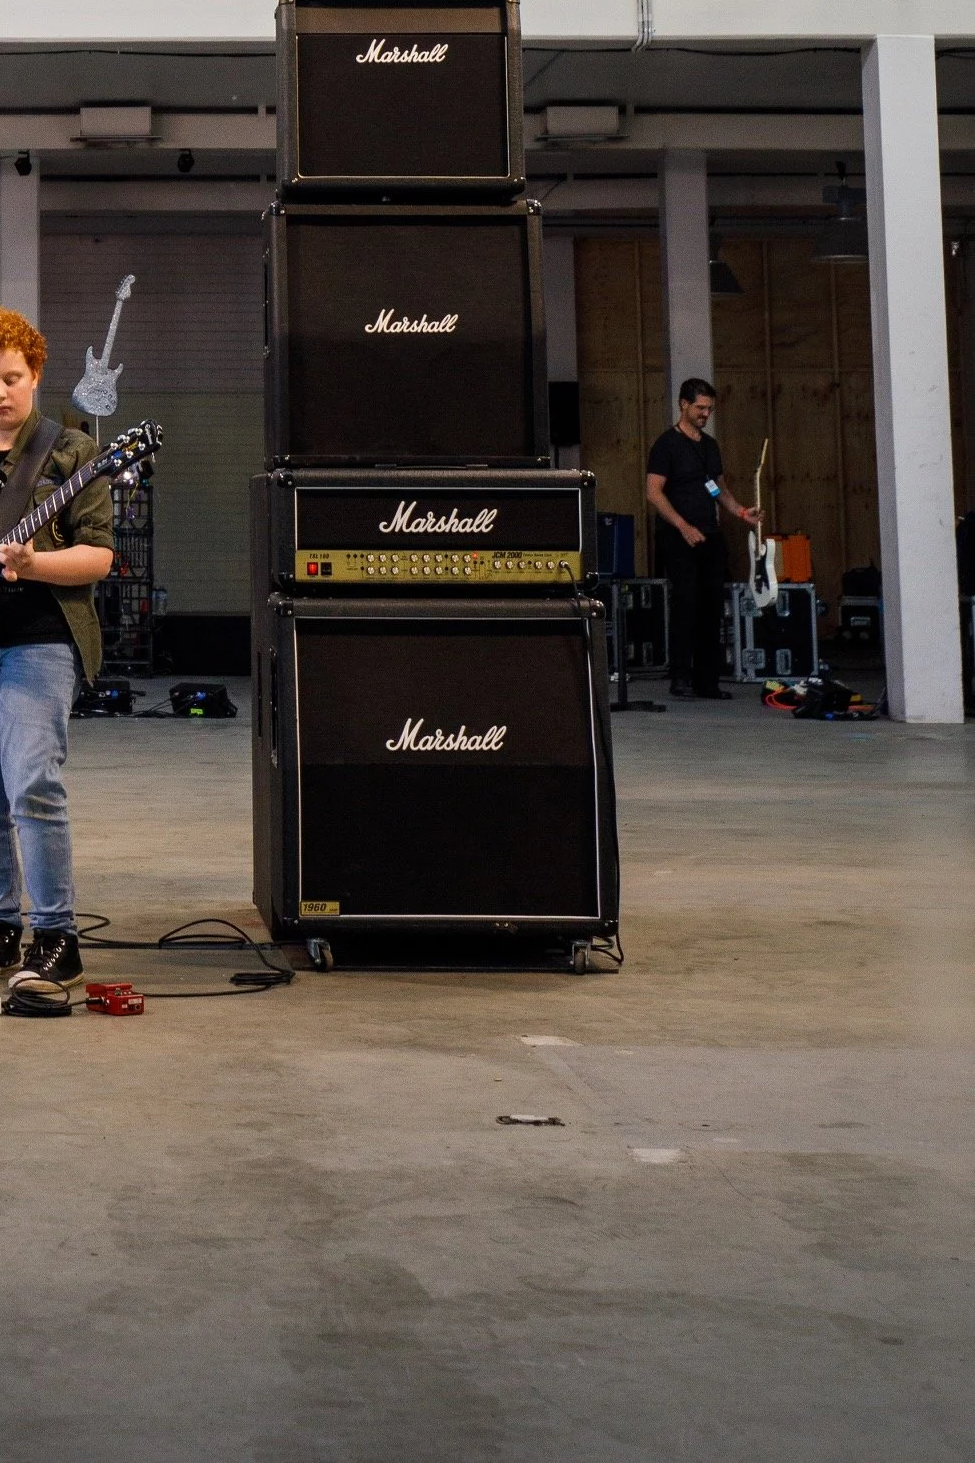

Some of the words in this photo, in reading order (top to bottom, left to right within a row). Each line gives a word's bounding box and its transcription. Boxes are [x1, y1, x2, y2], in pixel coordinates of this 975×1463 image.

[355, 38, 449, 64] Marshall
[364, 308, 459, 333] Marshall
[378, 500, 498, 533] Marshall
[492, 551, 506, 559] JCM
[385, 717, 507, 751] Marshall
[303, 903, 327, 912] 1960
